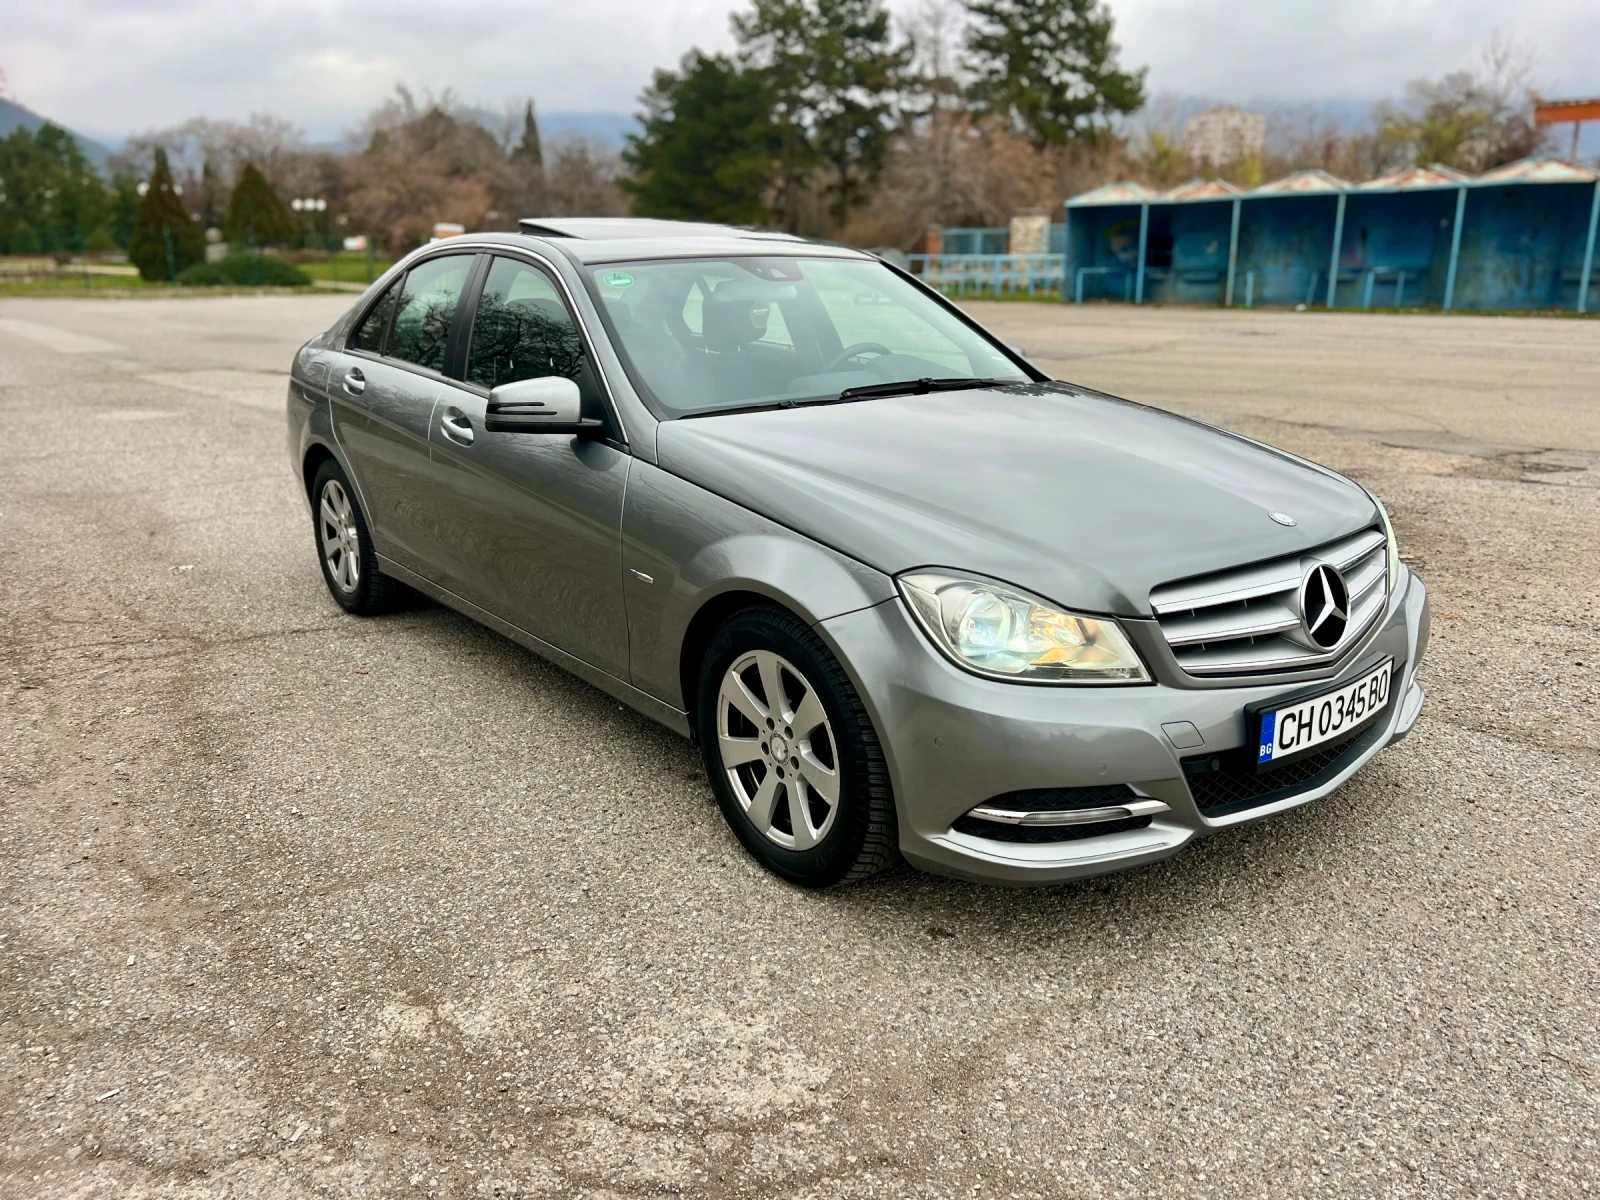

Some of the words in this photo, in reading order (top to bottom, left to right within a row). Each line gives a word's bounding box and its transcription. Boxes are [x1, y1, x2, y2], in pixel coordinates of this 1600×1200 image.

[1279, 706, 1314, 750] CH
[1319, 682, 1367, 736] 0345
[1368, 669, 1388, 712] BO
[1260, 743, 1272, 756] BG
